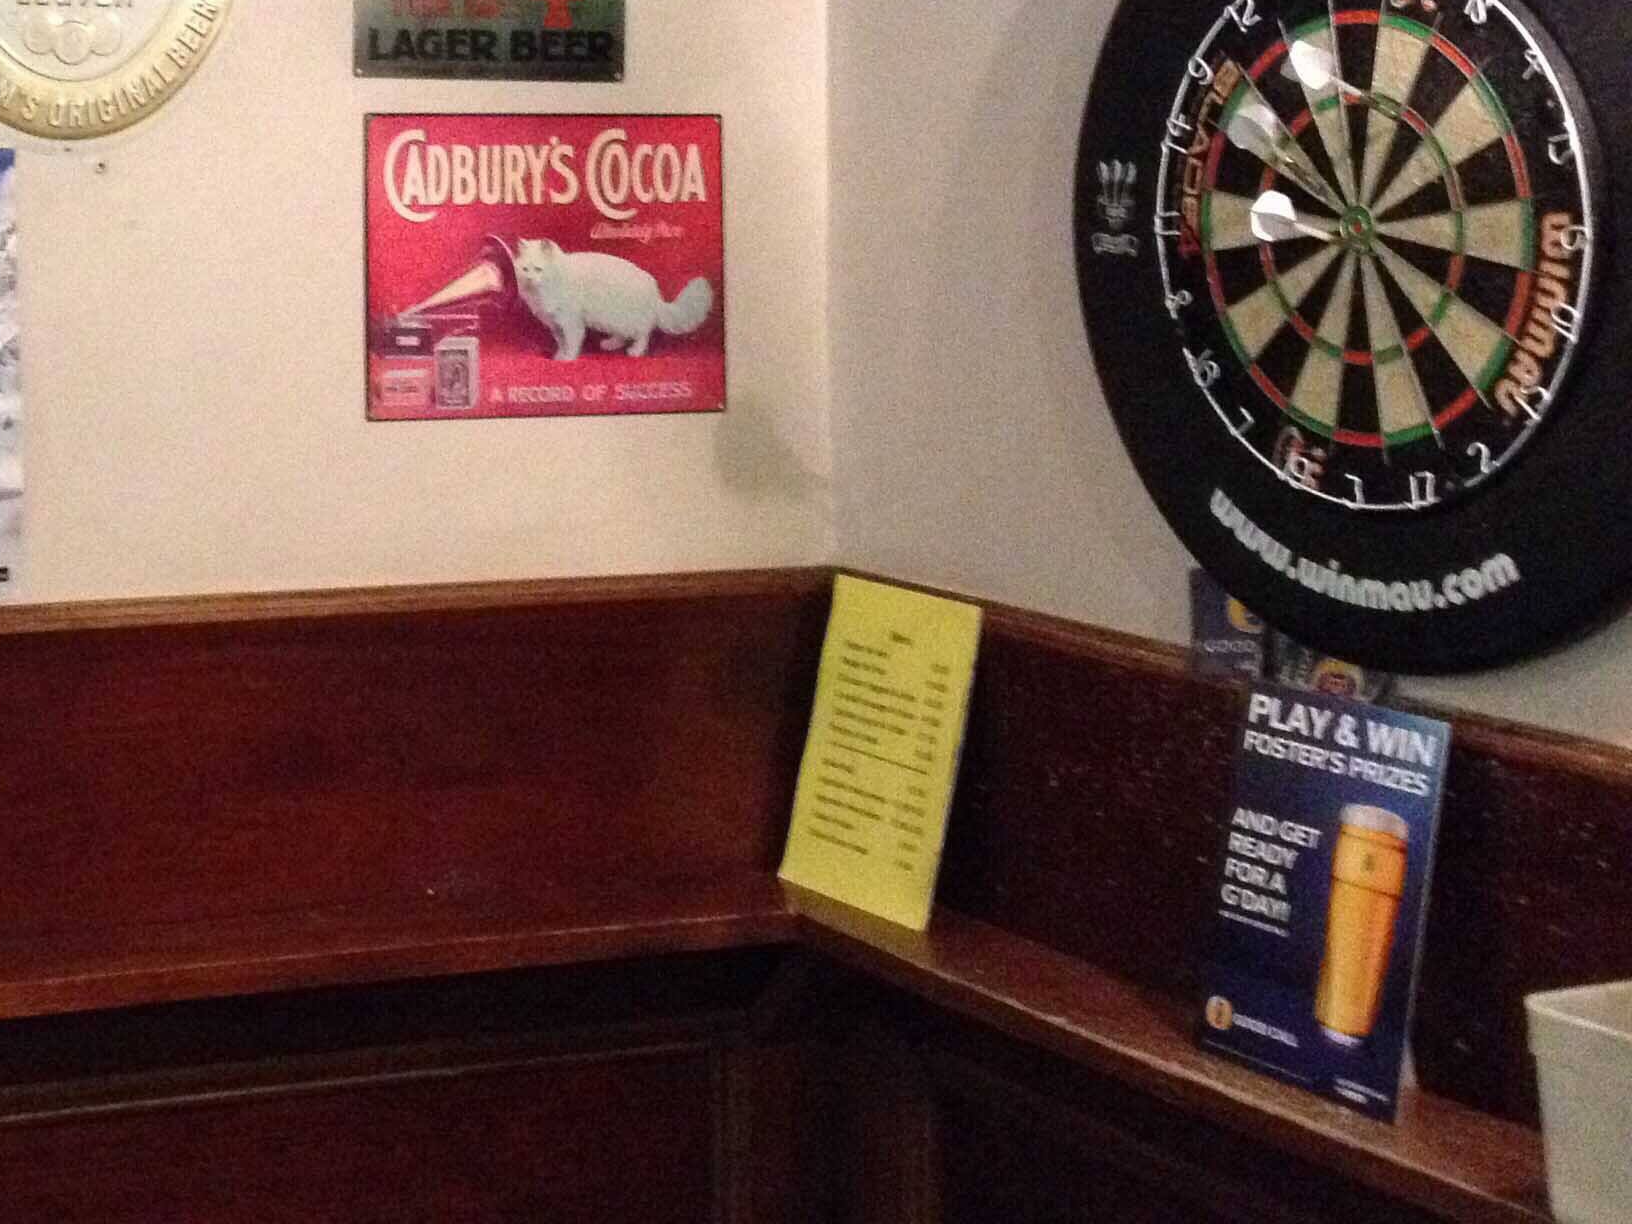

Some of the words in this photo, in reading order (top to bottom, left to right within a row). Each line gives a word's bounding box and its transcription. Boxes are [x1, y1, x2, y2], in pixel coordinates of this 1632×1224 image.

[368, 28, 499, 62] LAGER
[510, 29, 614, 62] BEER
[48, 64, 175, 128] ORIGINAL
[383, 128, 580, 223] CADBURY'S
[585, 128, 708, 220] COCOA
[507, 384, 576, 404] RECORD
[583, 384, 608, 402] OF
[614, 381, 694, 402] SUCCESS
[1209, 487, 1521, 613] www.winmau.com
[1247, 692, 1334, 741] PLAY
[1334, 713, 1361, 750] &
[1366, 718, 1440, 768] WIN
[1348, 755, 1431, 797] PRIZES
[1231, 806, 1279, 837] AND
[1279, 819, 1324, 850] GET
[1227, 830, 1300, 871] READY
[1224, 856, 1269, 889] FOR
[1269, 872, 1288, 895] A
